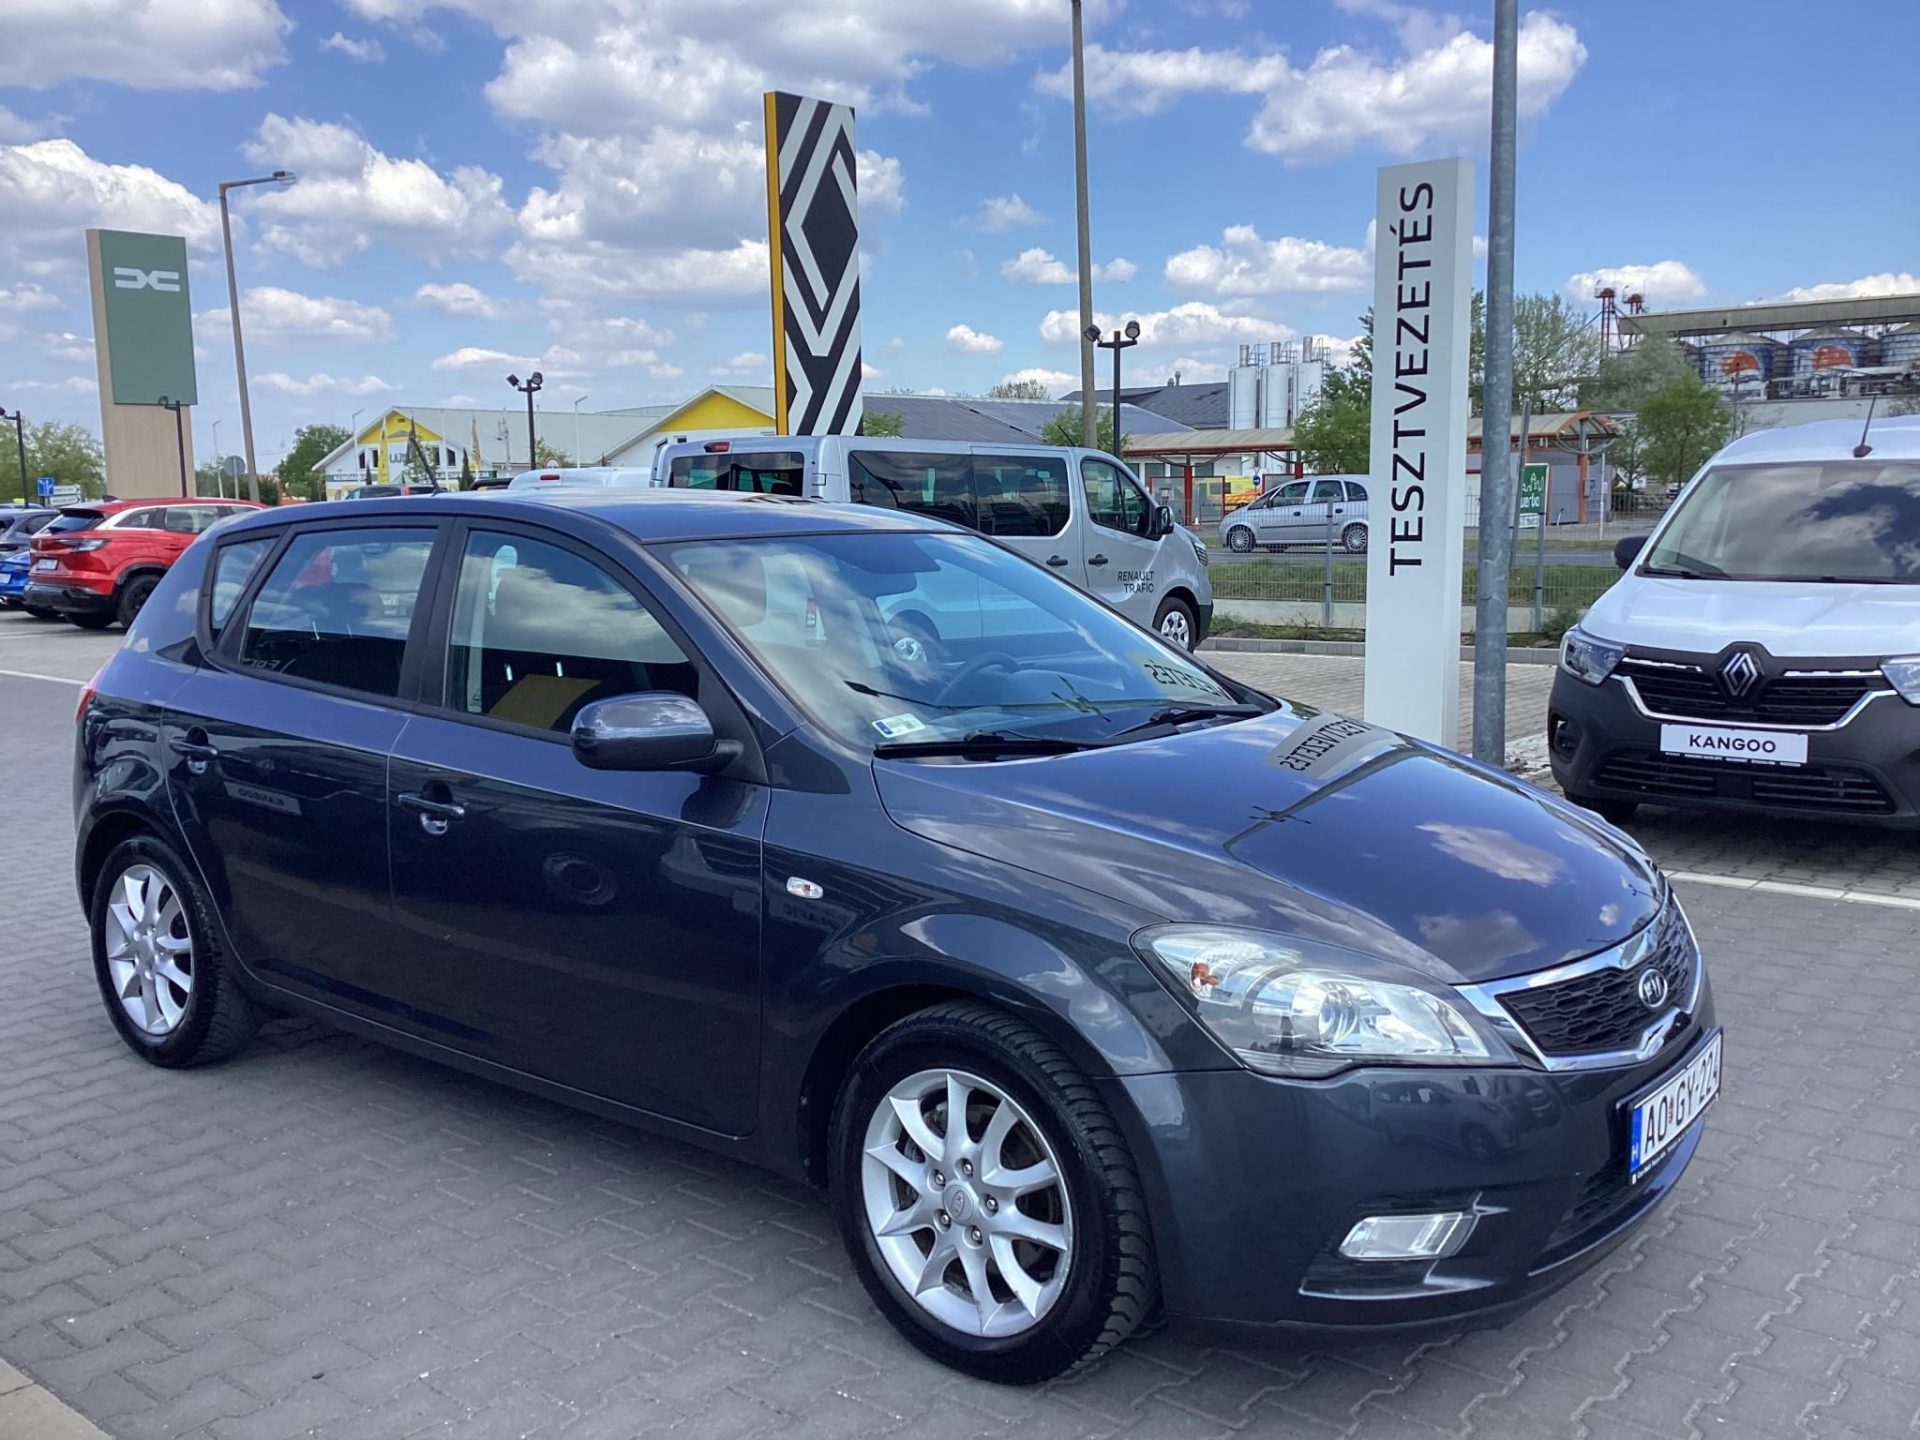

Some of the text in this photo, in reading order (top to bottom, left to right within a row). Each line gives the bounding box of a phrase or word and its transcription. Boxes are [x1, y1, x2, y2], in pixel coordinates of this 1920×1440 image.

[1388, 182, 1434, 577] TESZTVEZETÉS
[1117, 570, 1155, 582] RENAULT
[1123, 583, 1155, 594] TRAFIC
[1689, 734, 1776, 753] KANGOO
